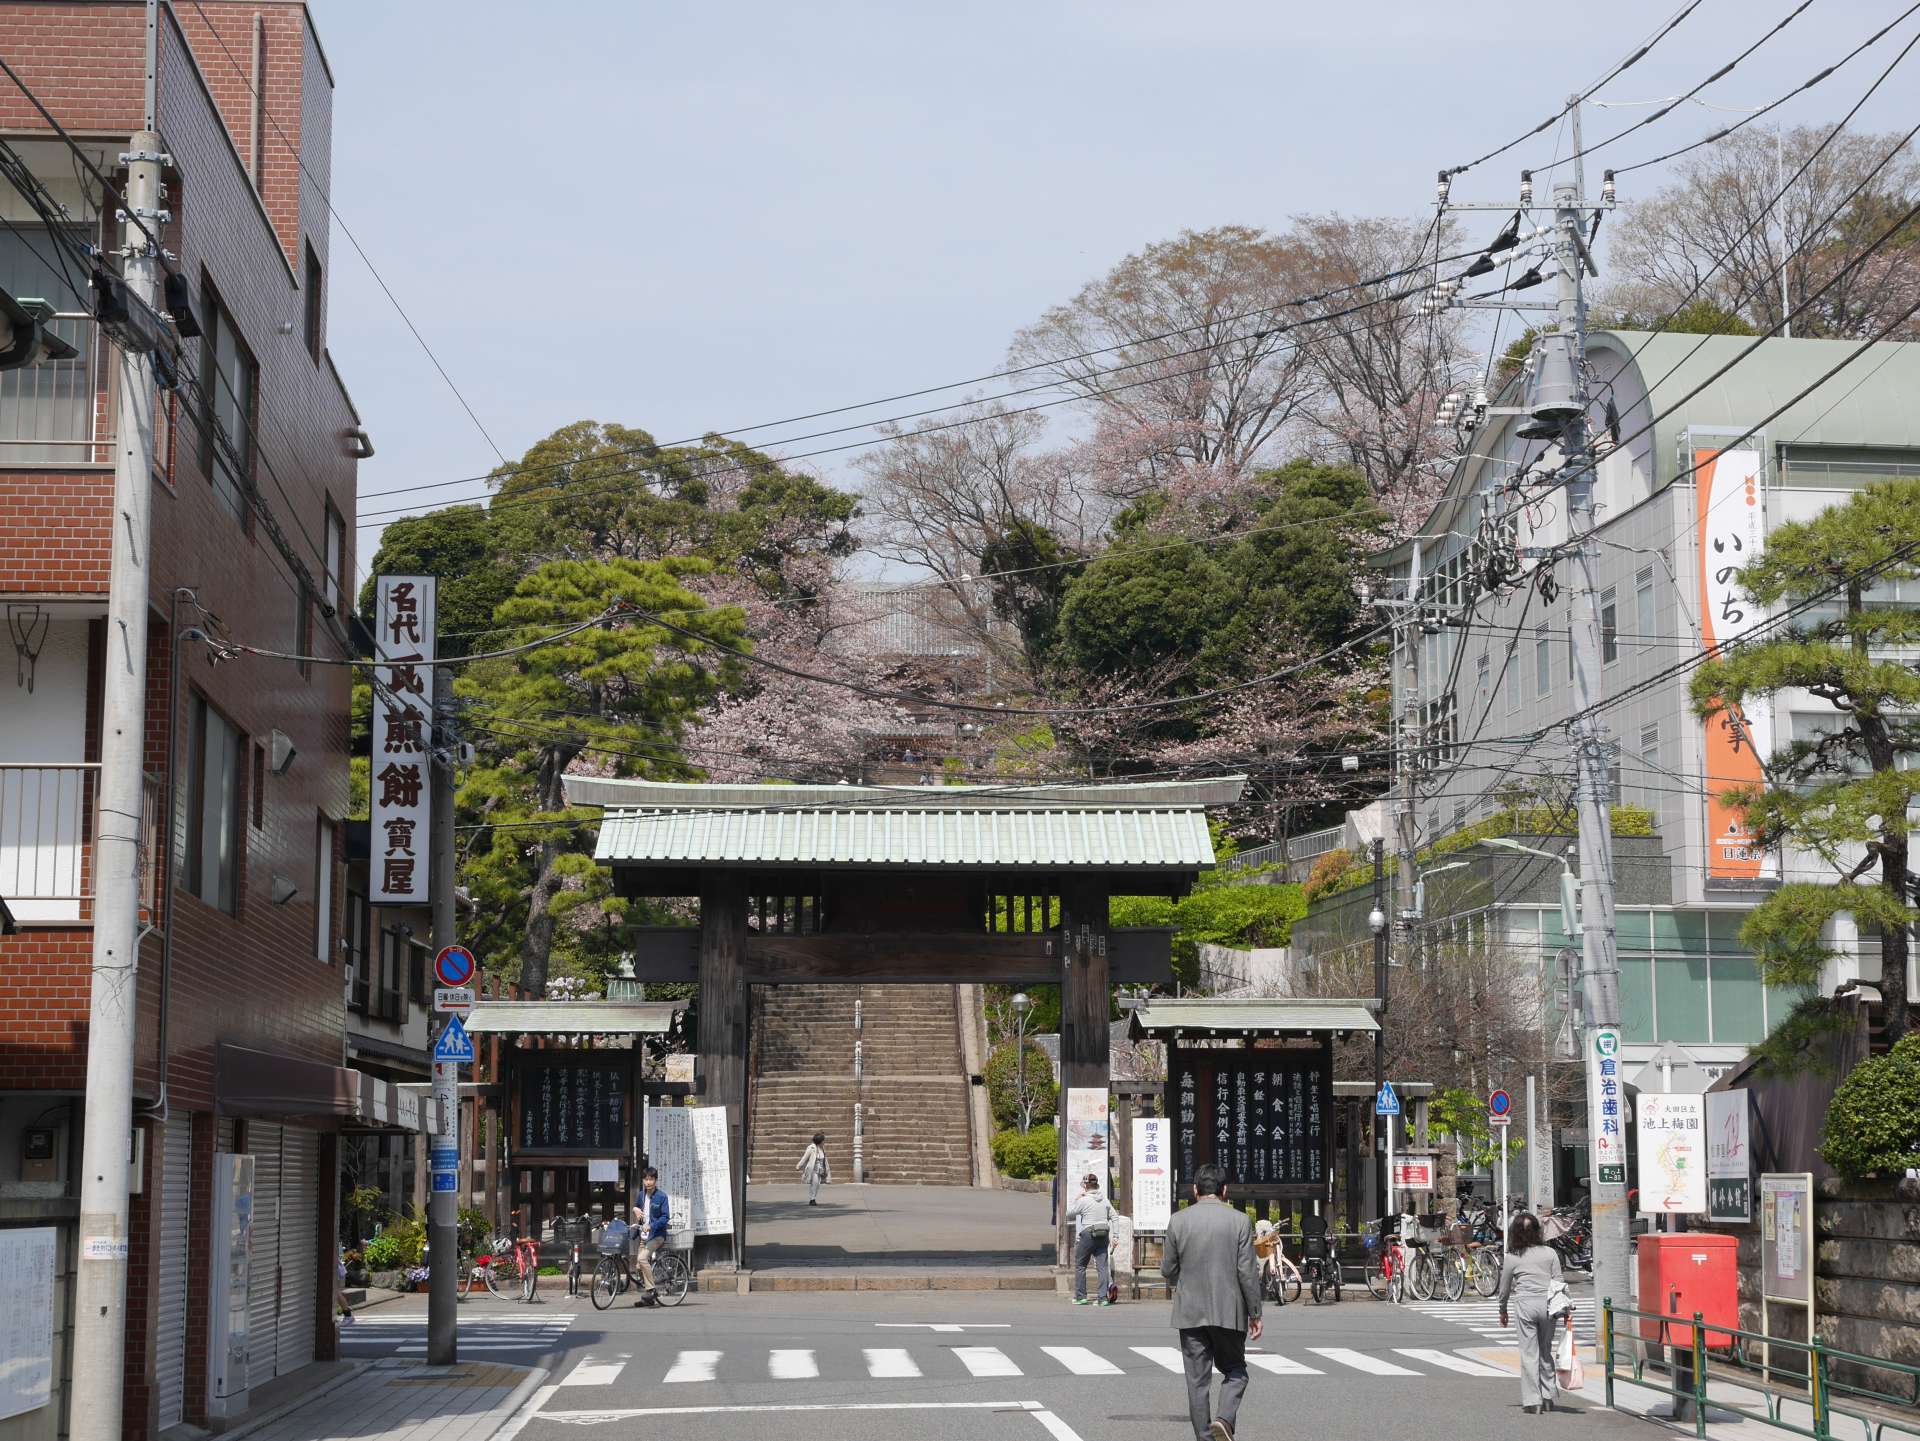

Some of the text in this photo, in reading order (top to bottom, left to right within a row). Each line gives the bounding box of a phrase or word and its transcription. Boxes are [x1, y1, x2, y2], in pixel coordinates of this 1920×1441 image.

[1272, 1072, 1286, 1141] 朝食会
[1600, 1058, 1619, 1136] 倉治歯科
[1664, 1104, 1697, 1113] 大田区立
[1145, 1121, 1159, 1164] 朗子会館
[1642, 1117, 1699, 1130] 池上梅園
